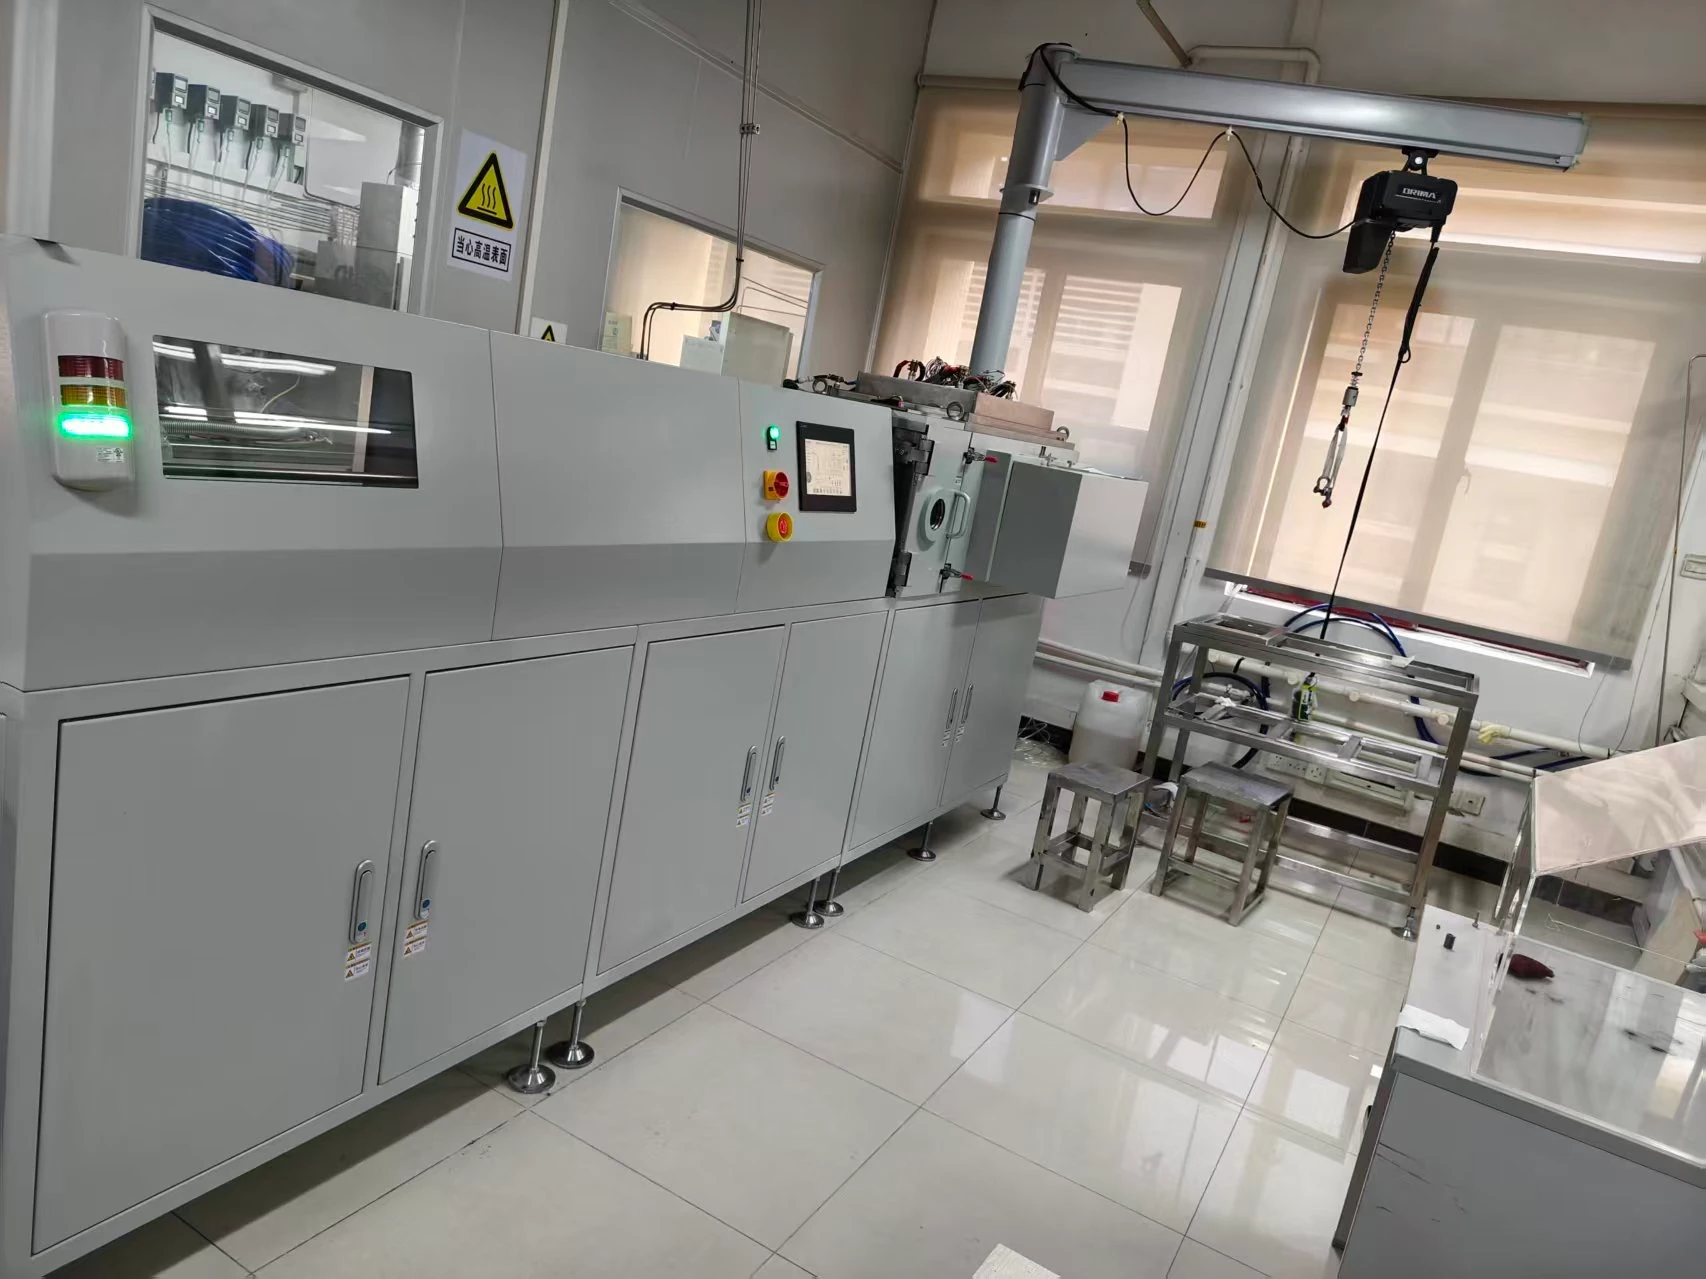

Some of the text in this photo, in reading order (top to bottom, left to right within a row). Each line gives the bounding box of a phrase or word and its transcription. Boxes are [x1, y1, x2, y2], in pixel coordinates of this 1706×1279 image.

[455, 235, 508, 266] 当心高温表面
